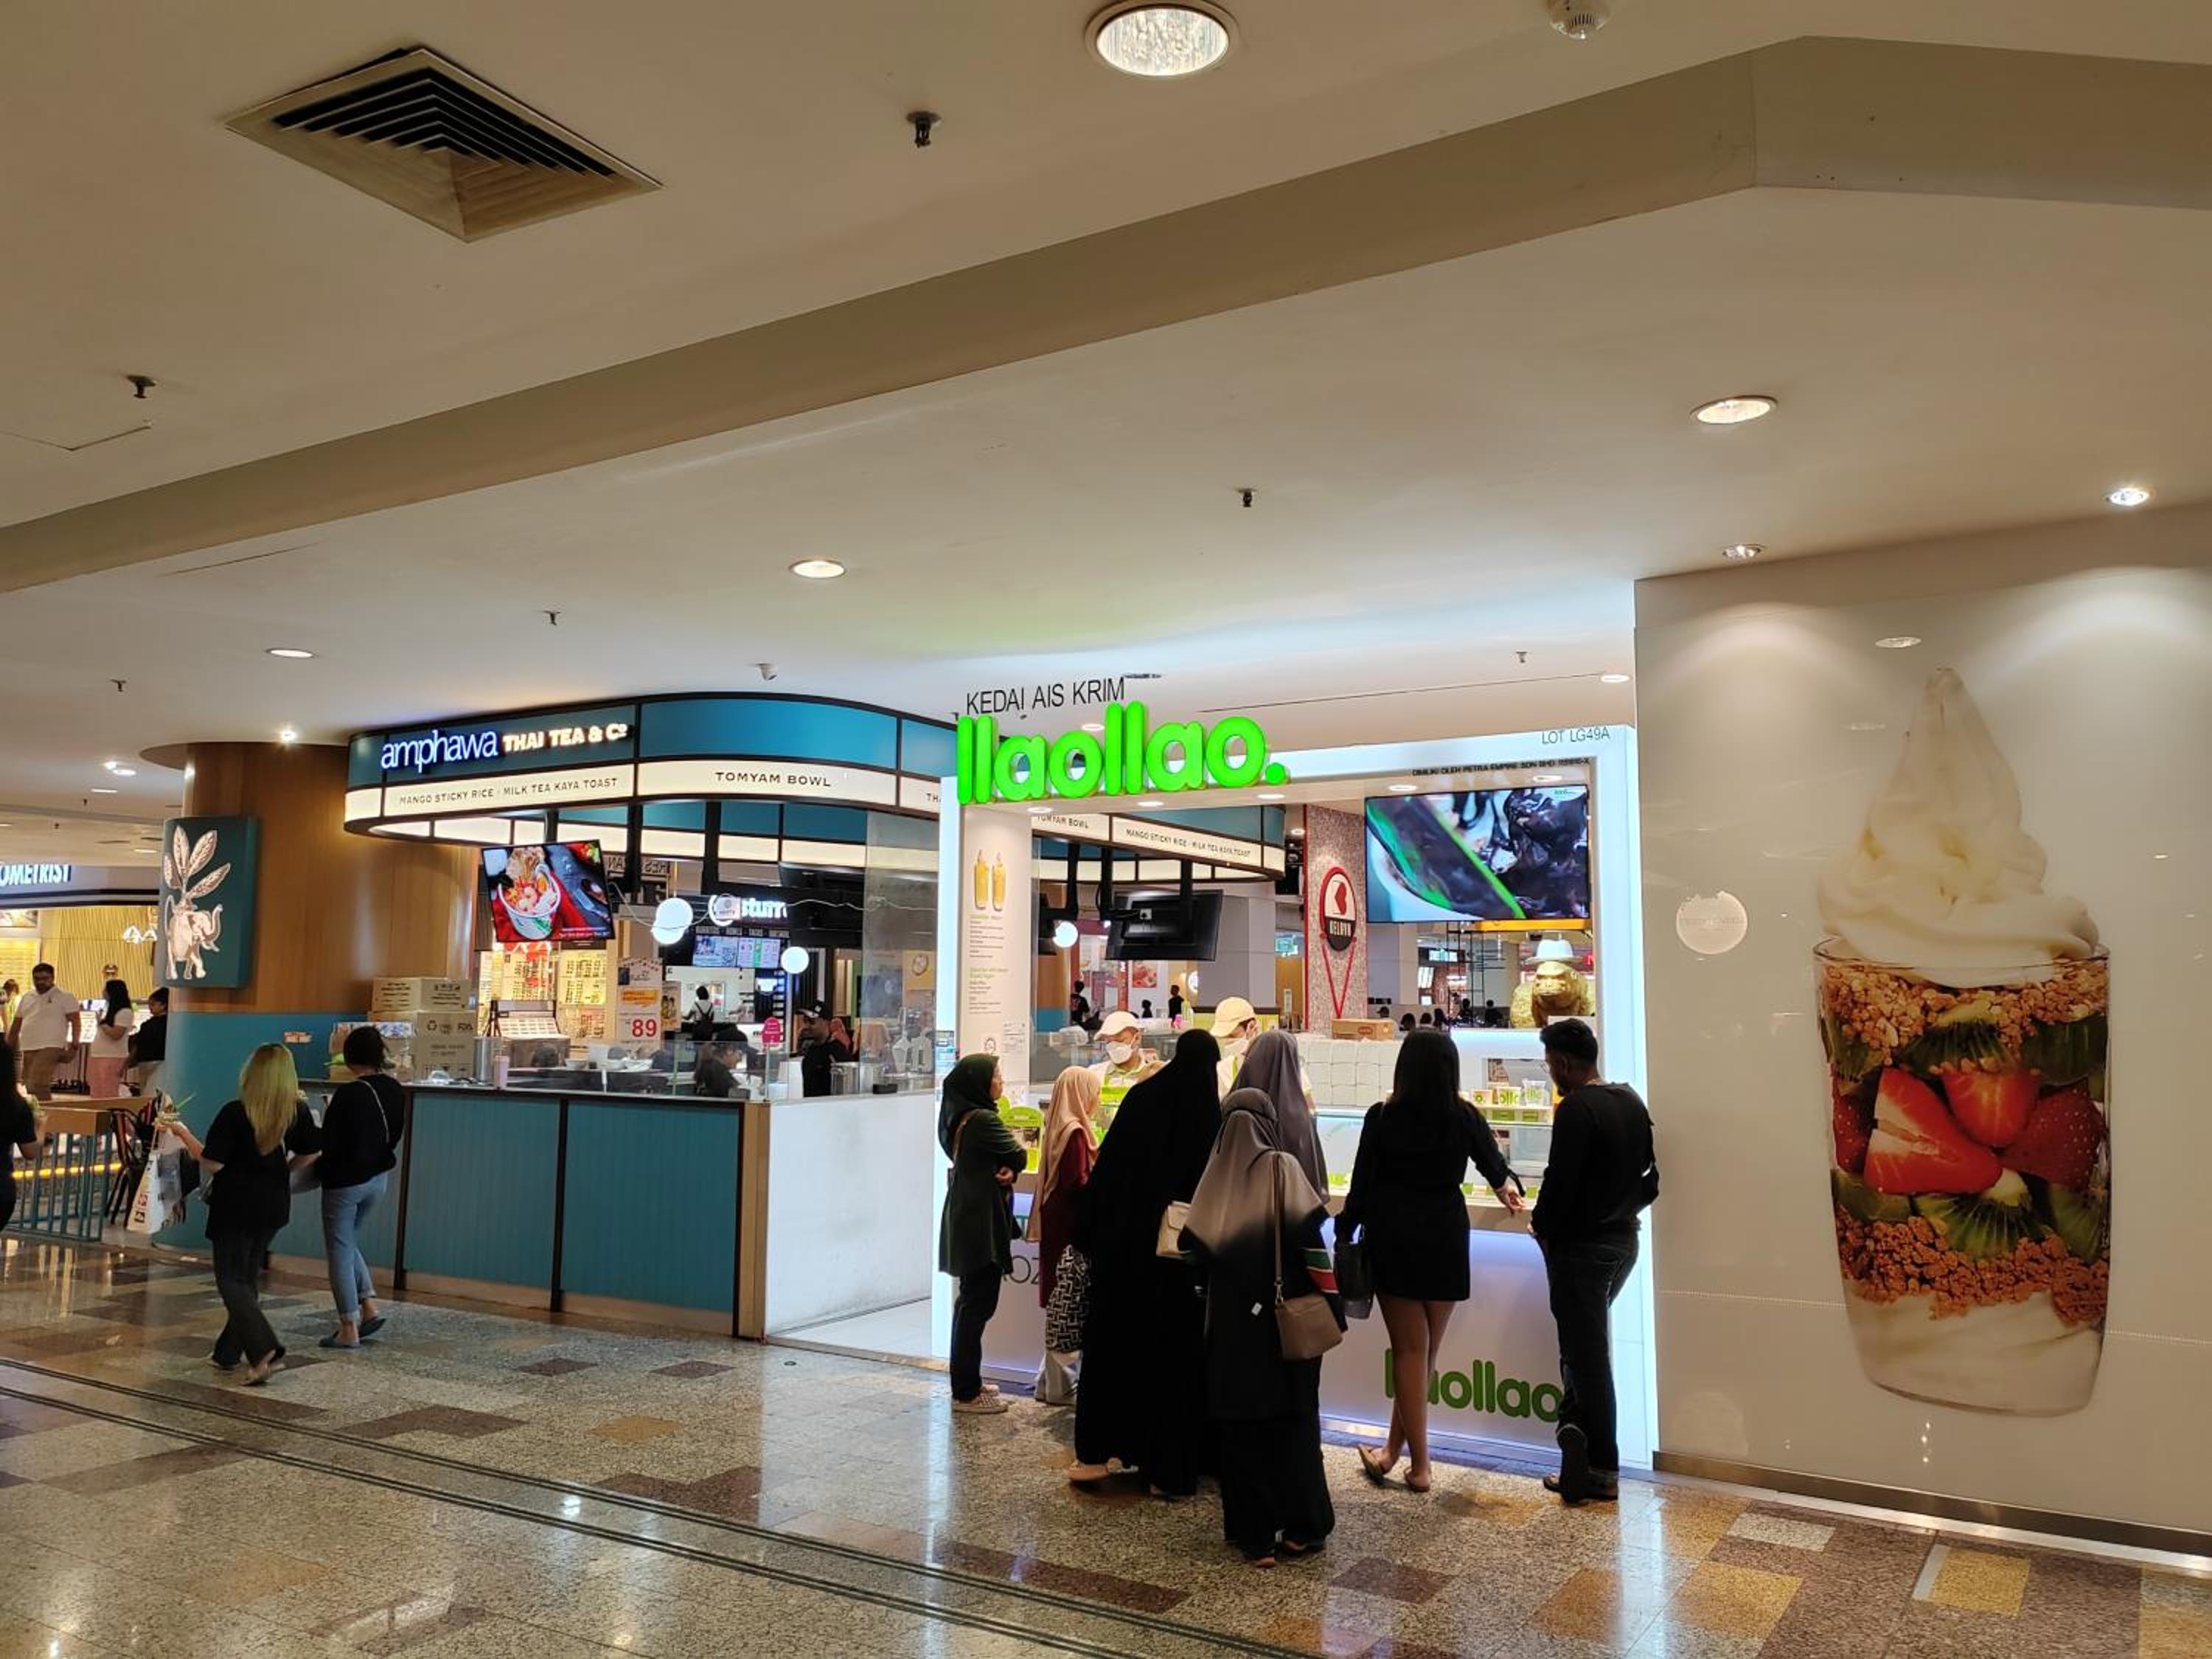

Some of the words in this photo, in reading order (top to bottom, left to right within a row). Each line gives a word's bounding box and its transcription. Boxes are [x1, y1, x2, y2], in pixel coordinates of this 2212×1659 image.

[967, 687, 1024, 714] KEDAI
[1032, 684, 1064, 709] AIS
[1073, 677, 1124, 705] KRIM
[1542, 731, 1563, 744] LOT
[1570, 726, 1610, 742] LG49A
[381, 729, 498, 773] amphawa
[502, 731, 544, 752] THAI
[549, 727, 585, 747] TEA
[588, 726, 602, 742] &
[715, 772, 781, 783] TOMYAM
[787, 775, 832, 787] BOWL
[400, 794, 432, 804] MANGO
[435, 791, 468, 802] STICKY
[471, 788, 494, 799] RICE
[504, 786, 528, 796] MILK
[532, 783, 551, 793] TEA
[554, 781, 580, 791] KAYA
[583, 778, 618, 788] TOAST
[926, 793, 941, 803] TH
[1068, 818, 1089, 829] BOWL
[1126, 829, 1149, 840] MANGO
[1150, 833, 1172, 844] STICKY
[632, 1019, 657, 1037] 89
